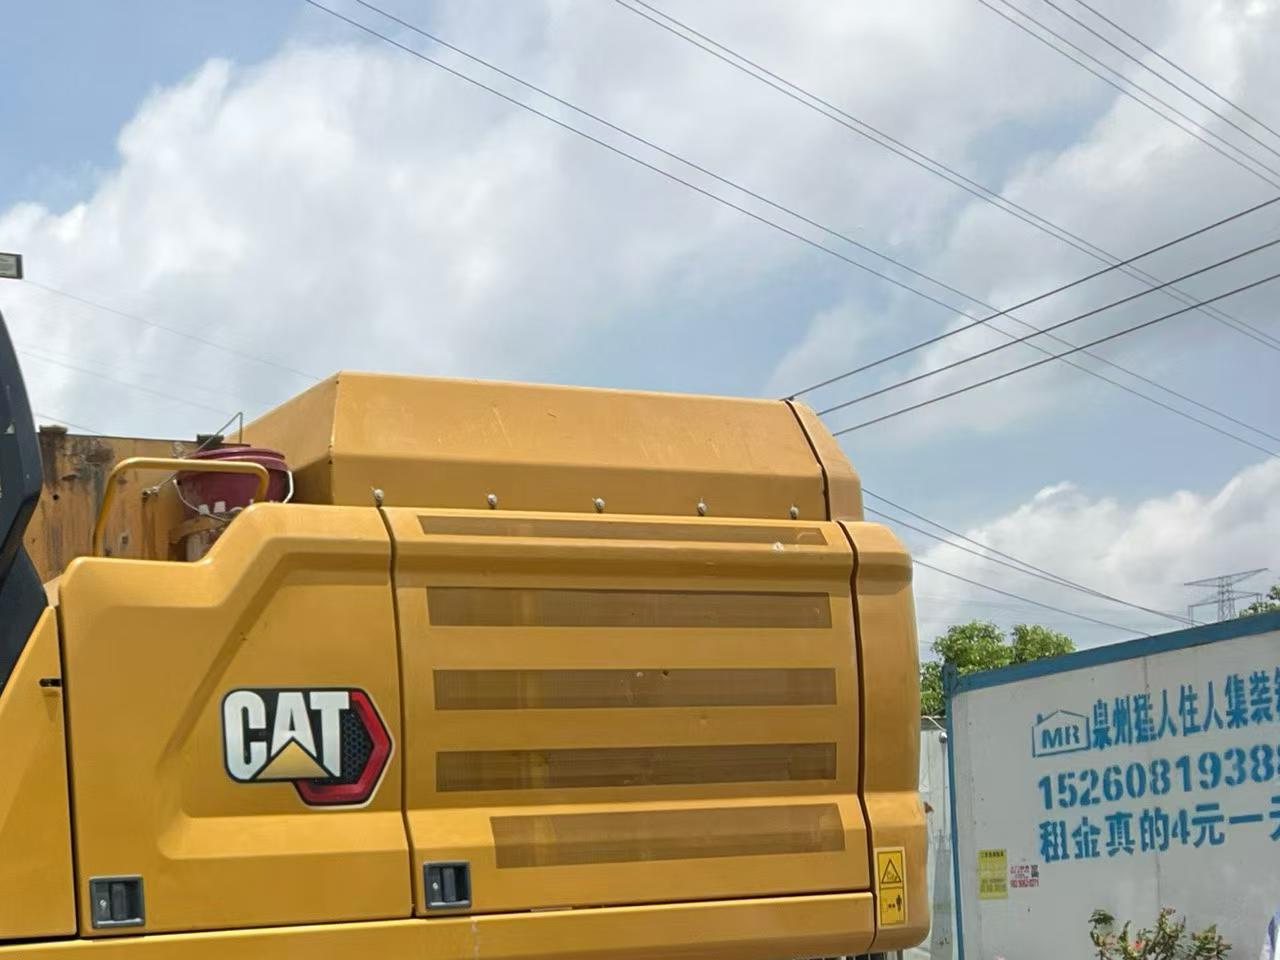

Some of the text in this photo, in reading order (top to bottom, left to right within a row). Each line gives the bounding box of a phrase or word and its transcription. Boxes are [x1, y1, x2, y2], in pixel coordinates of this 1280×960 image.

[223, 690, 350, 780] CAT
[1041, 725, 1080, 749] MR
[1038, 744, 1280, 810] 1526081938
